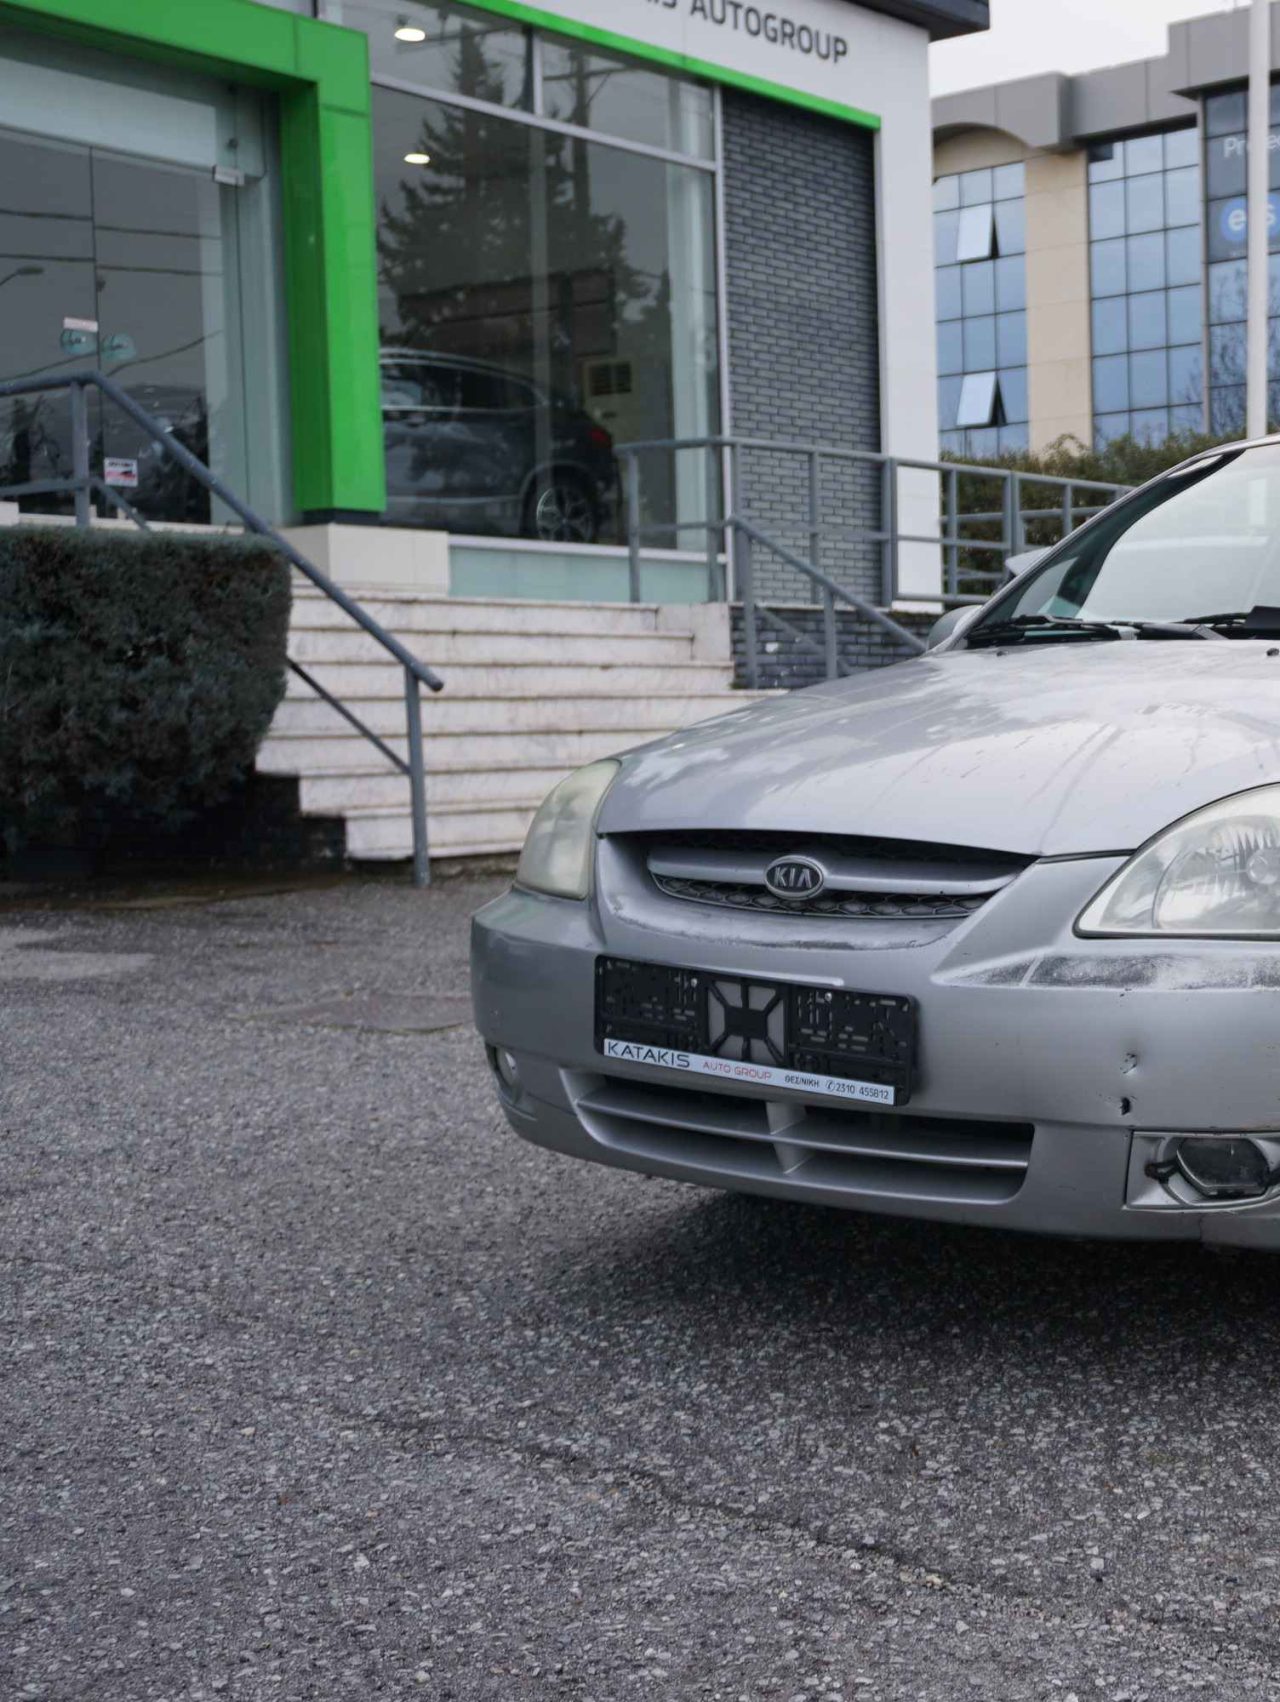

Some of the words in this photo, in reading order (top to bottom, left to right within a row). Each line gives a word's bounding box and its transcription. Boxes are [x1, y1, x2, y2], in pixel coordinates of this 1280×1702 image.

[690, 0, 848, 63] AUTOGROUP
[774, 866, 812, 889] KIA
[607, 1041, 690, 1068] KATAKIS
[703, 1061, 731, 1074] AUTO
[734, 1066, 772, 1081] GROUP
[835, 1081, 856, 1094] 2310
[858, 1086, 889, 1100] 455812
